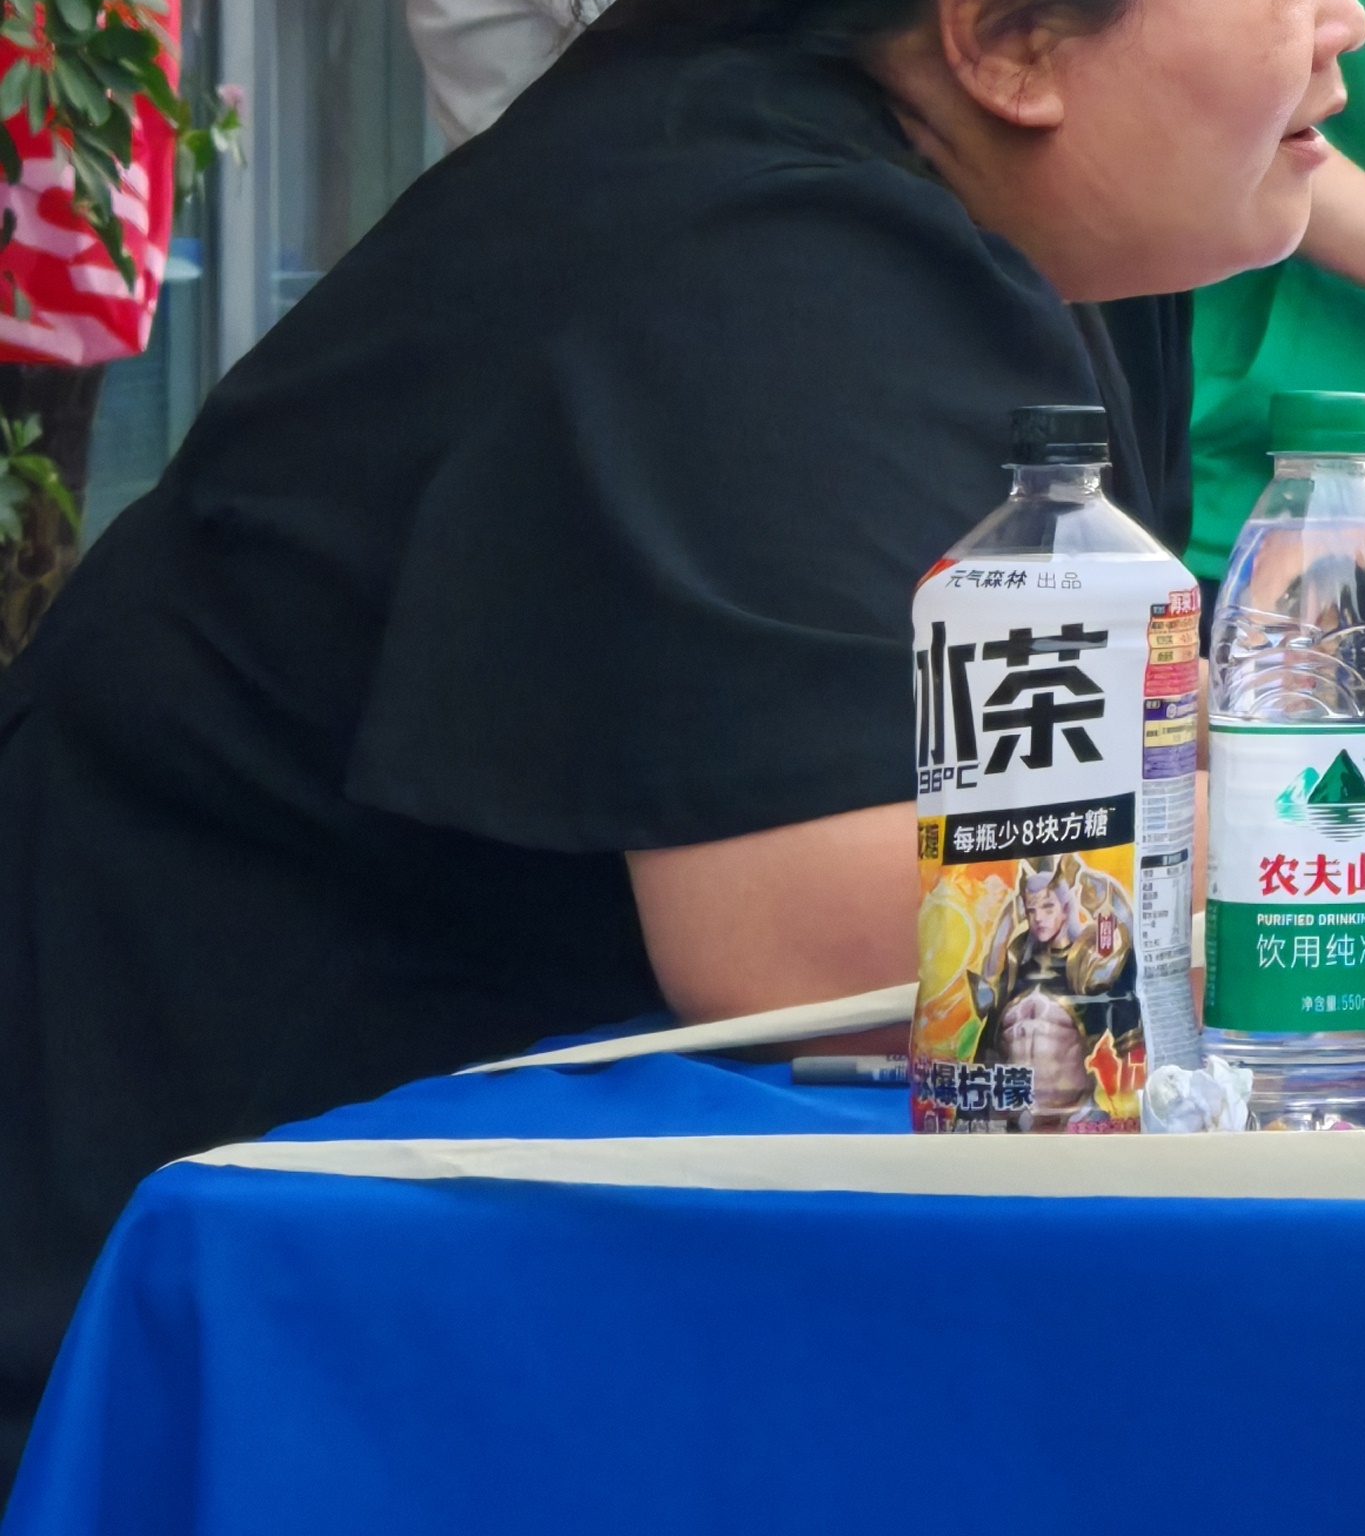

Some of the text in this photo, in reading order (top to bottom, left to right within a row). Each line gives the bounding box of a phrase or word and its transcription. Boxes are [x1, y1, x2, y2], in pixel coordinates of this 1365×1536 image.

[945, 569, 1082, 589] 元气森林 出品
[953, 807, 1112, 853] 每瓶少8块方糖
[1257, 913, 1315, 926] PURIFIED
